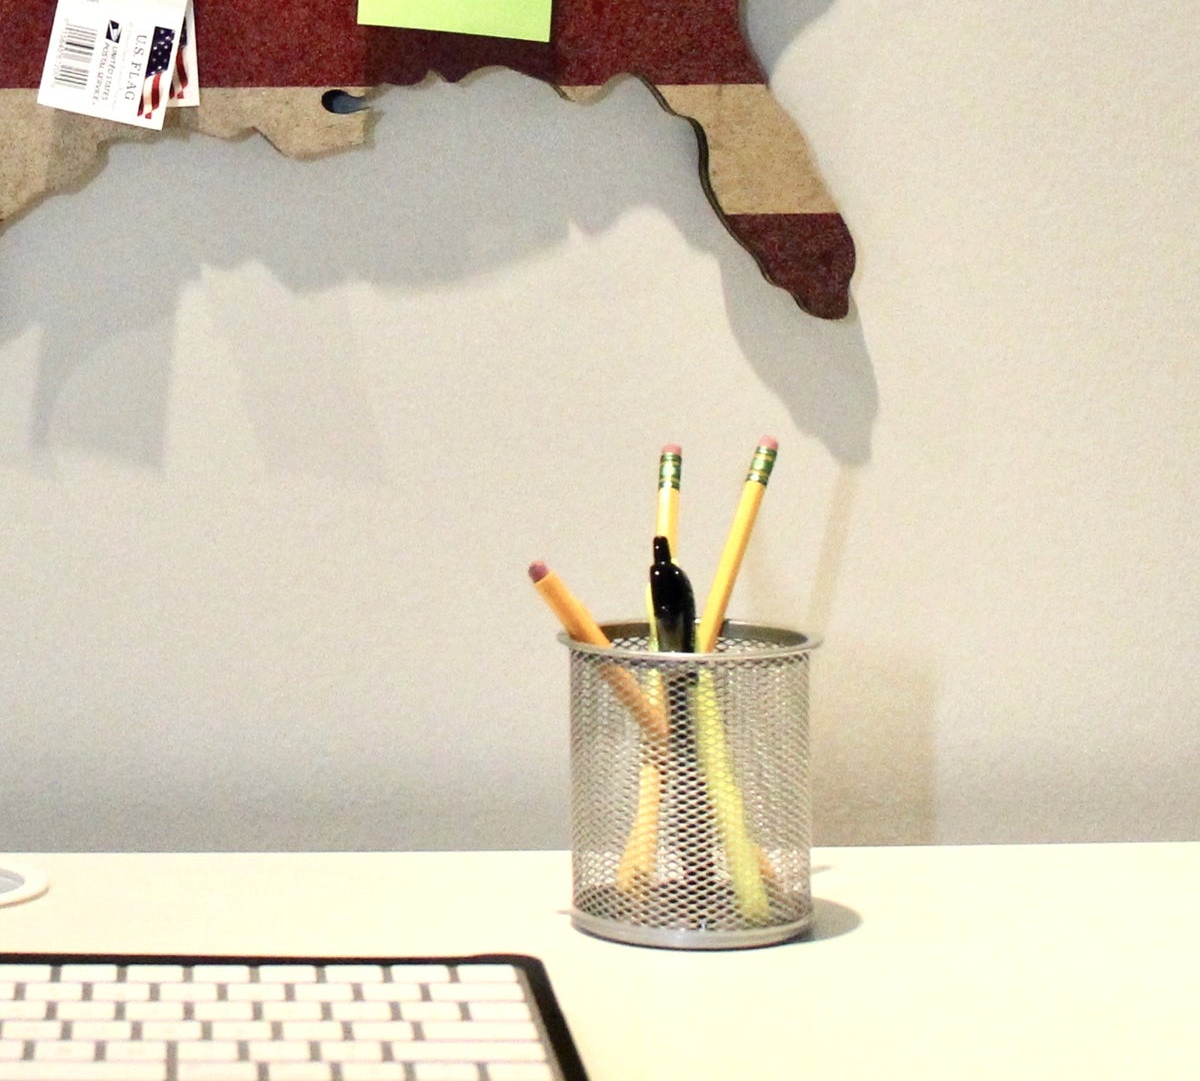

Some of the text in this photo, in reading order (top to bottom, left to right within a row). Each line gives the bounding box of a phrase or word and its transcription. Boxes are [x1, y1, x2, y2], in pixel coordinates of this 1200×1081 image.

[98, 42, 109, 69] POSTAL
[102, 46, 118, 101] UNITED STATES
[125, 34, 147, 101] U.S. FLAG
